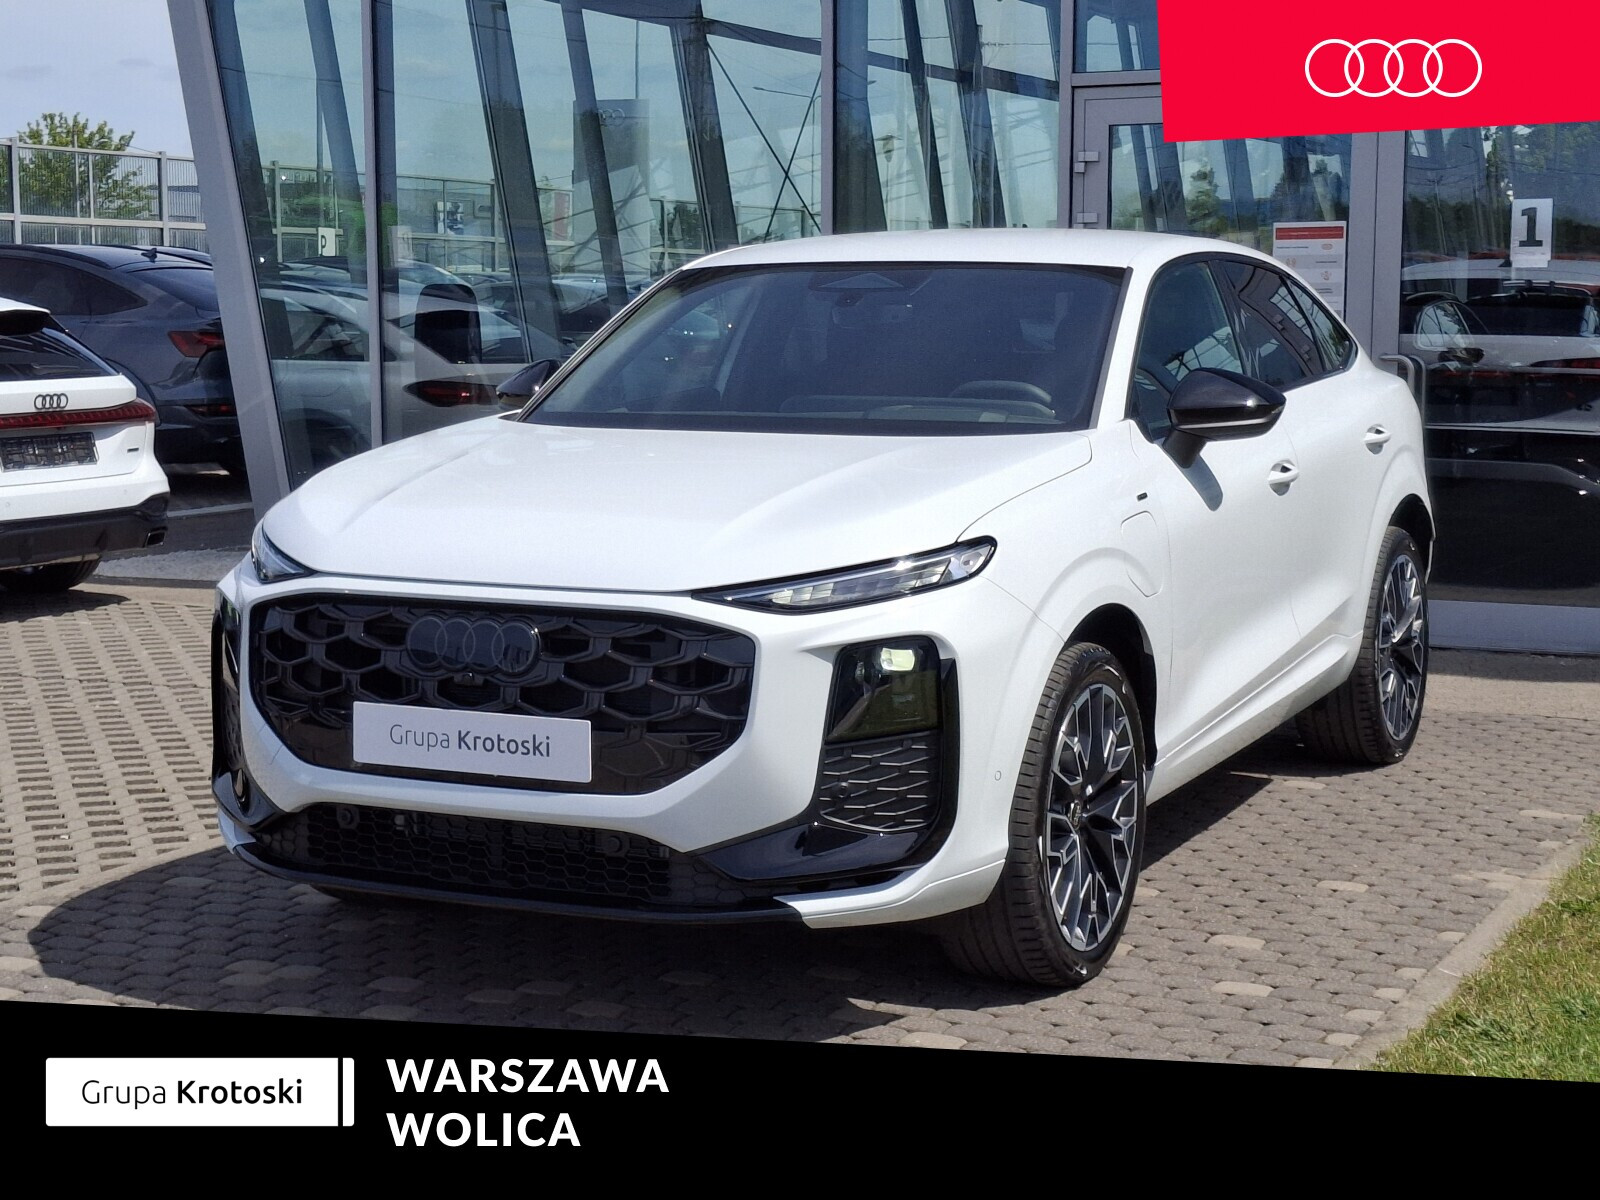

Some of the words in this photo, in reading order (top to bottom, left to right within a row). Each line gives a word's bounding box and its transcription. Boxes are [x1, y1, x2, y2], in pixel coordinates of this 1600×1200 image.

[1519, 207, 1543, 247] 1
[389, 724, 450, 752] Grupa
[457, 729, 550, 758] Krotoski
